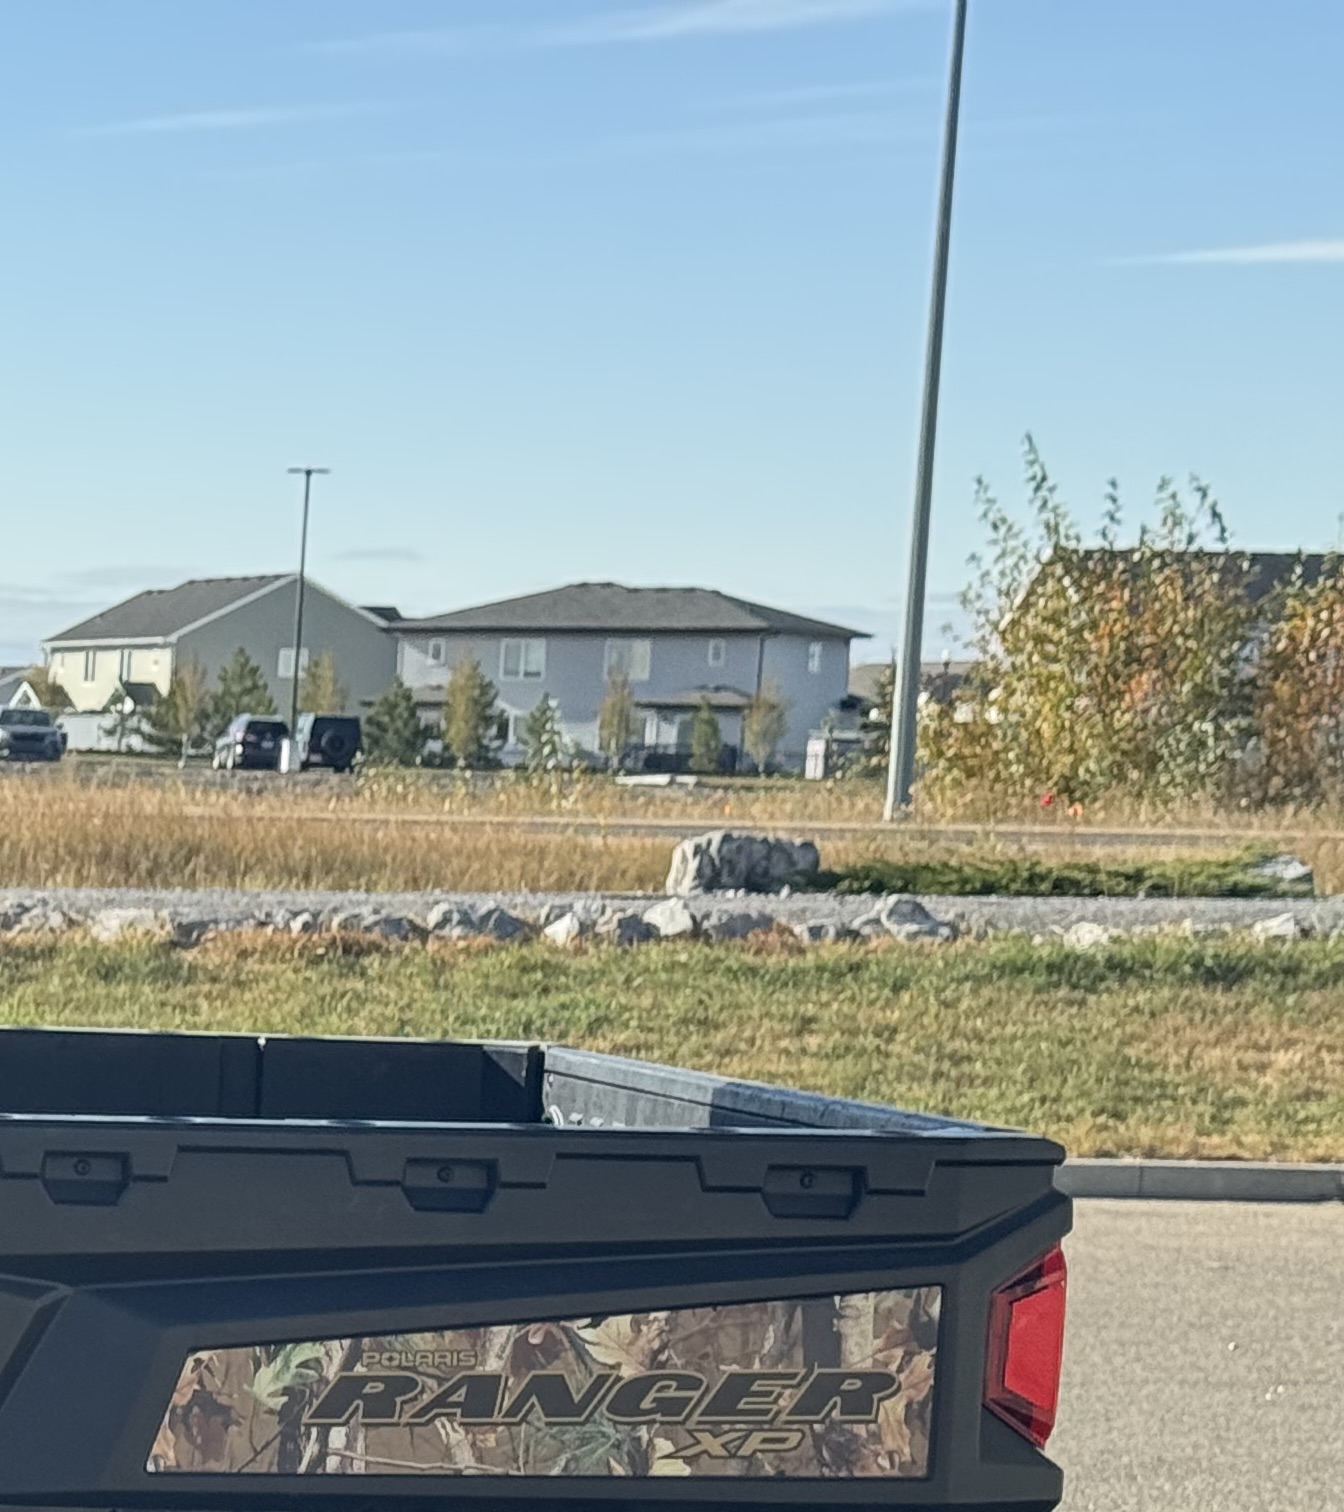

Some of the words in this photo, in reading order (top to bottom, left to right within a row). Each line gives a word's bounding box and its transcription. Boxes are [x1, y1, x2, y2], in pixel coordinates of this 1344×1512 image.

[362, 1350, 478, 1368] POLARIS
[301, 1367, 903, 1427] RANGER
[664, 1427, 809, 1460] XP
